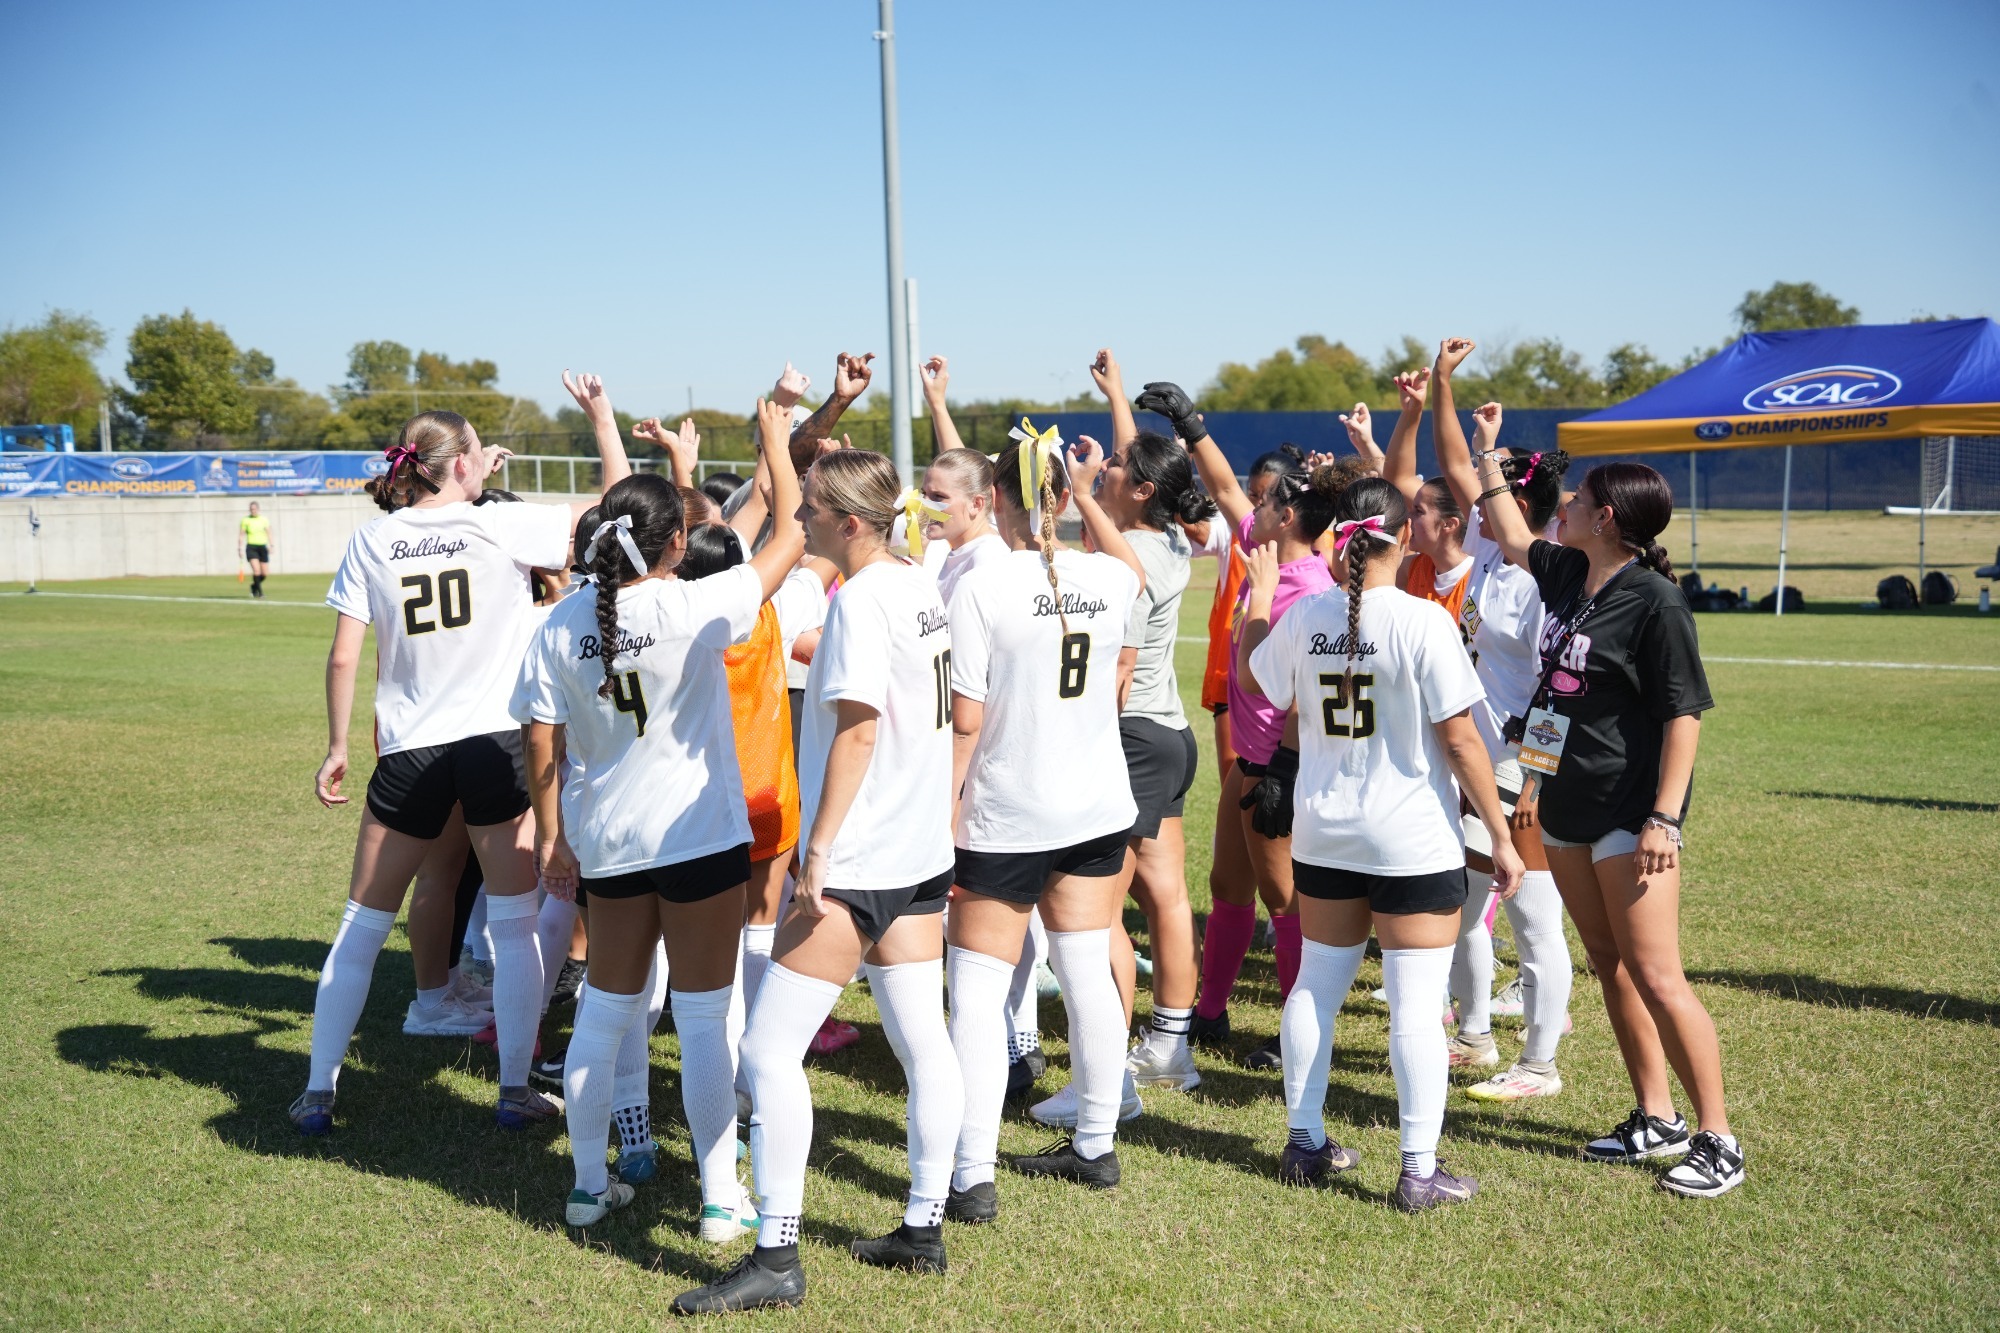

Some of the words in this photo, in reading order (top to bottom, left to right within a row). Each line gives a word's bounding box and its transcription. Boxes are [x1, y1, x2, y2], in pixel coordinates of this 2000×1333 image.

[1763, 382, 1880, 405] SCAC
[1699, 422, 1730, 436] SCAC
[1736, 411, 1889, 436] CHAMPIONSHIPS
[66, 480, 196, 493] CHAMPIONSHIPS
[389, 536, 468, 561] Bulldogs
[401, 568, 472, 636] 20
[1571, 603, 1595, 633] SONY
[578, 630, 656, 660] Budogs
[1059, 632, 1091, 699] 8
[612, 670, 648, 738] 4
[933, 648, 952, 732] 10
[1319, 673, 1375, 739] 26
[1520, 751, 1558, 768] ALL-ACCESS
